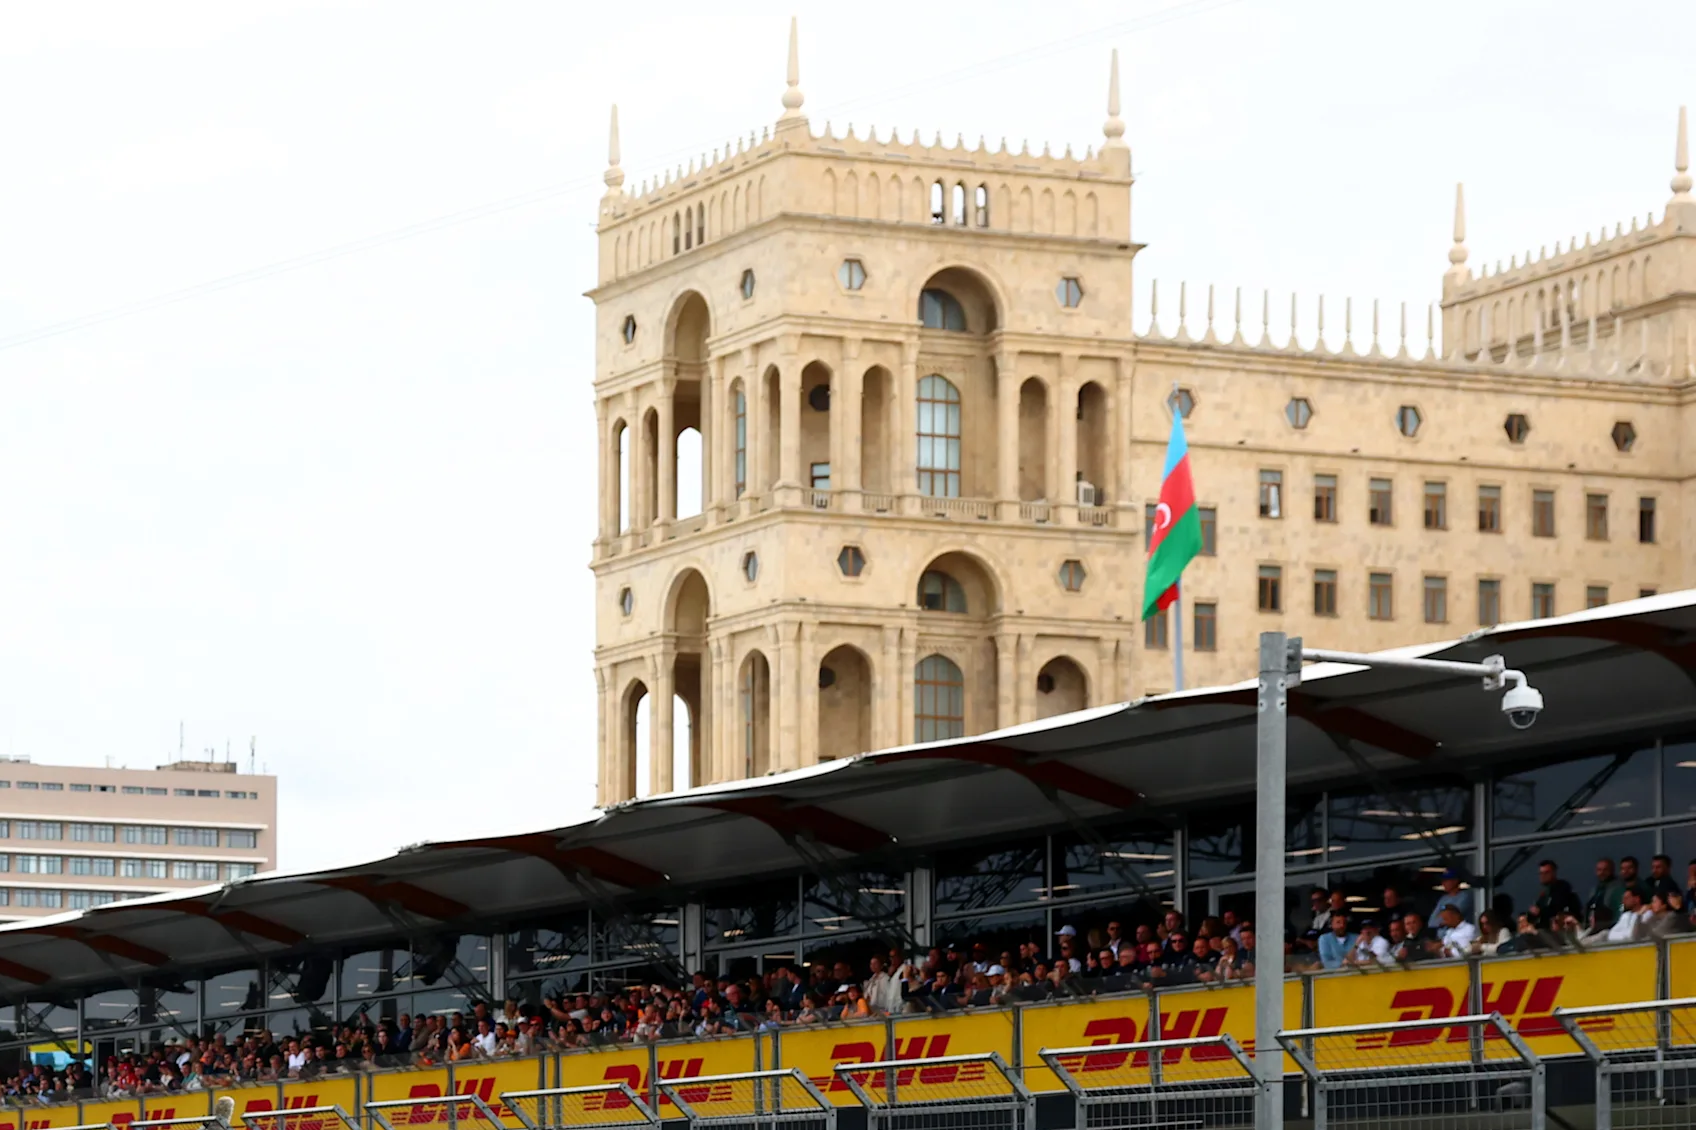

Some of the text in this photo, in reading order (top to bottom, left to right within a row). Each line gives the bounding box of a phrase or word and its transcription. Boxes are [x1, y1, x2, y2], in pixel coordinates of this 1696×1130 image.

[1388, 976, 1565, 1048] DHL
[828, 1035, 957, 1085] DHL
[1083, 1008, 1240, 1071] DHL
[408, 1078, 497, 1125] DHL
[604, 1058, 704, 1109] DHL
